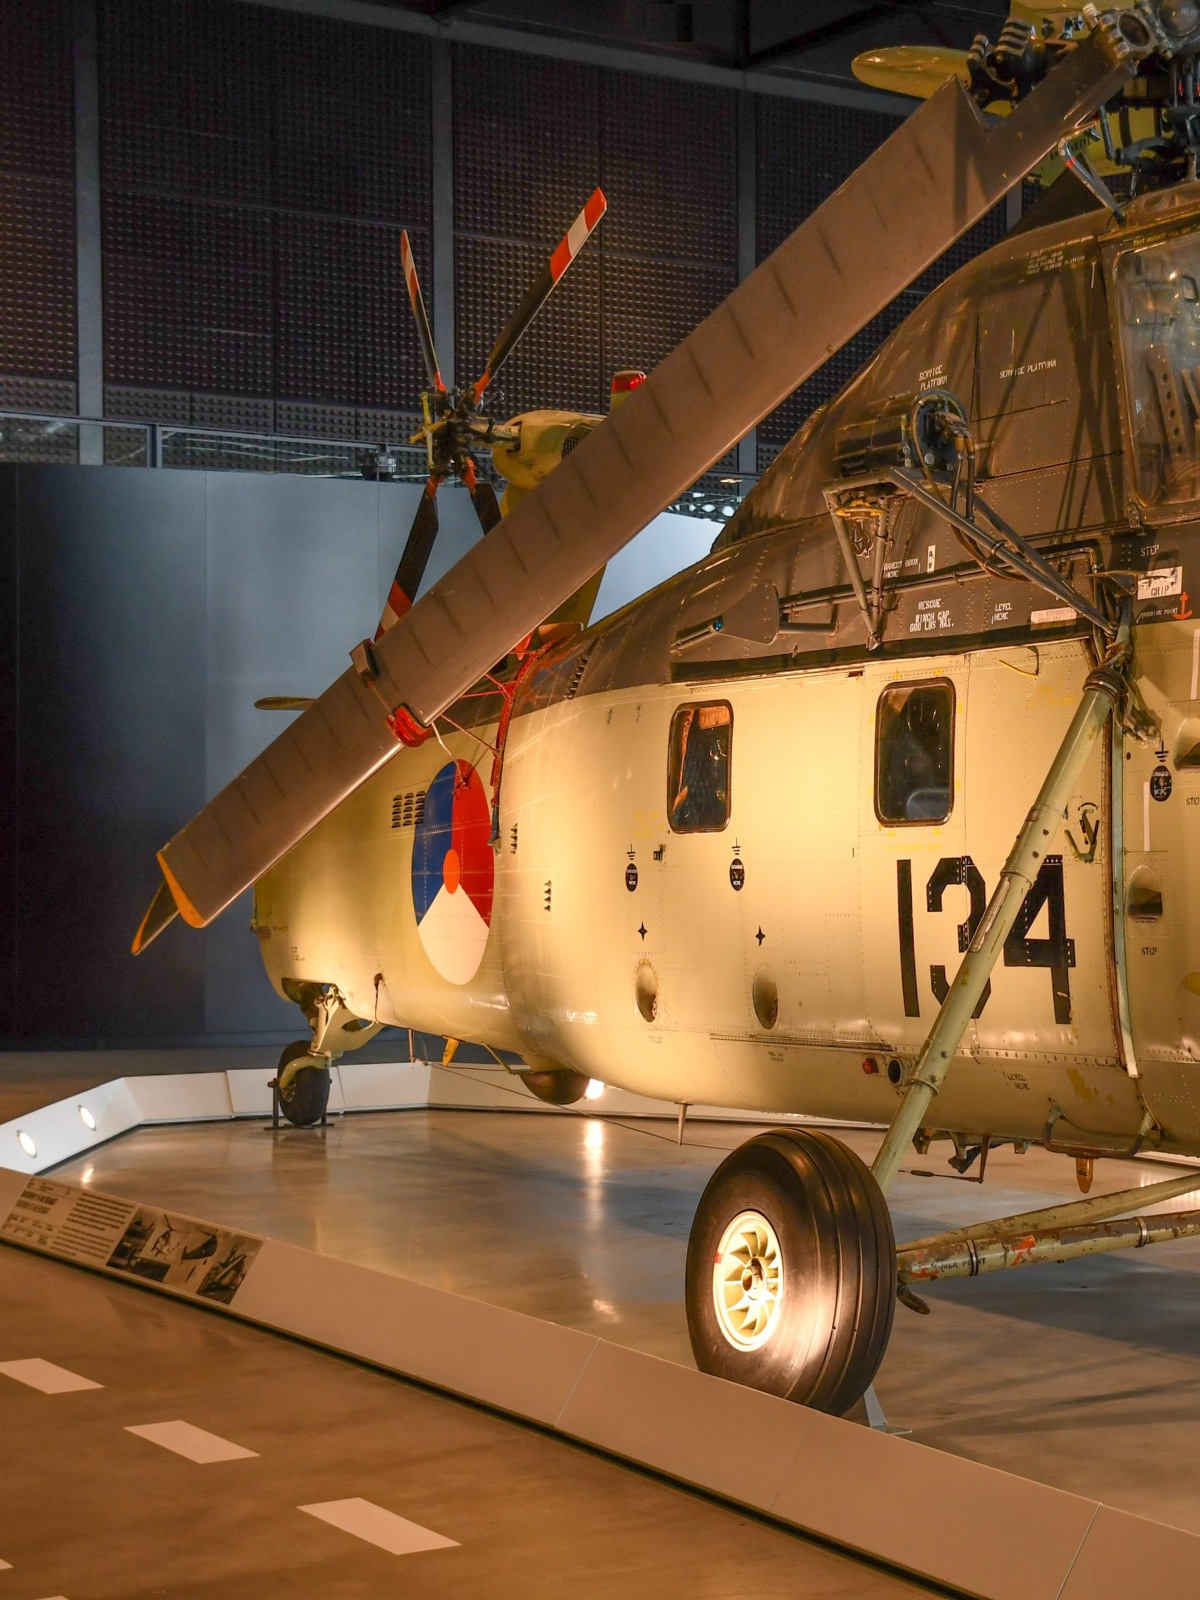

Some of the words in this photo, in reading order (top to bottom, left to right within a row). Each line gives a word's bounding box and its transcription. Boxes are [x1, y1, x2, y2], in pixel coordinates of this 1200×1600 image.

[918, 364, 943, 381] SERVICE
[999, 366, 1025, 379] SERVICE
[1027, 359, 1057, 373] PLATFORM
[920, 375, 948, 391] PLATFORM
[1140, 544, 1160, 557] STEP
[1150, 585, 1170, 597] GRIP
[917, 598, 942, 611] RESCUE
[994, 602, 1013, 612] LEVEL
[924, 621, 937, 631] LBS
[896, 854, 1077, 1025] 134
[1141, 946, 1158, 956] STEP
